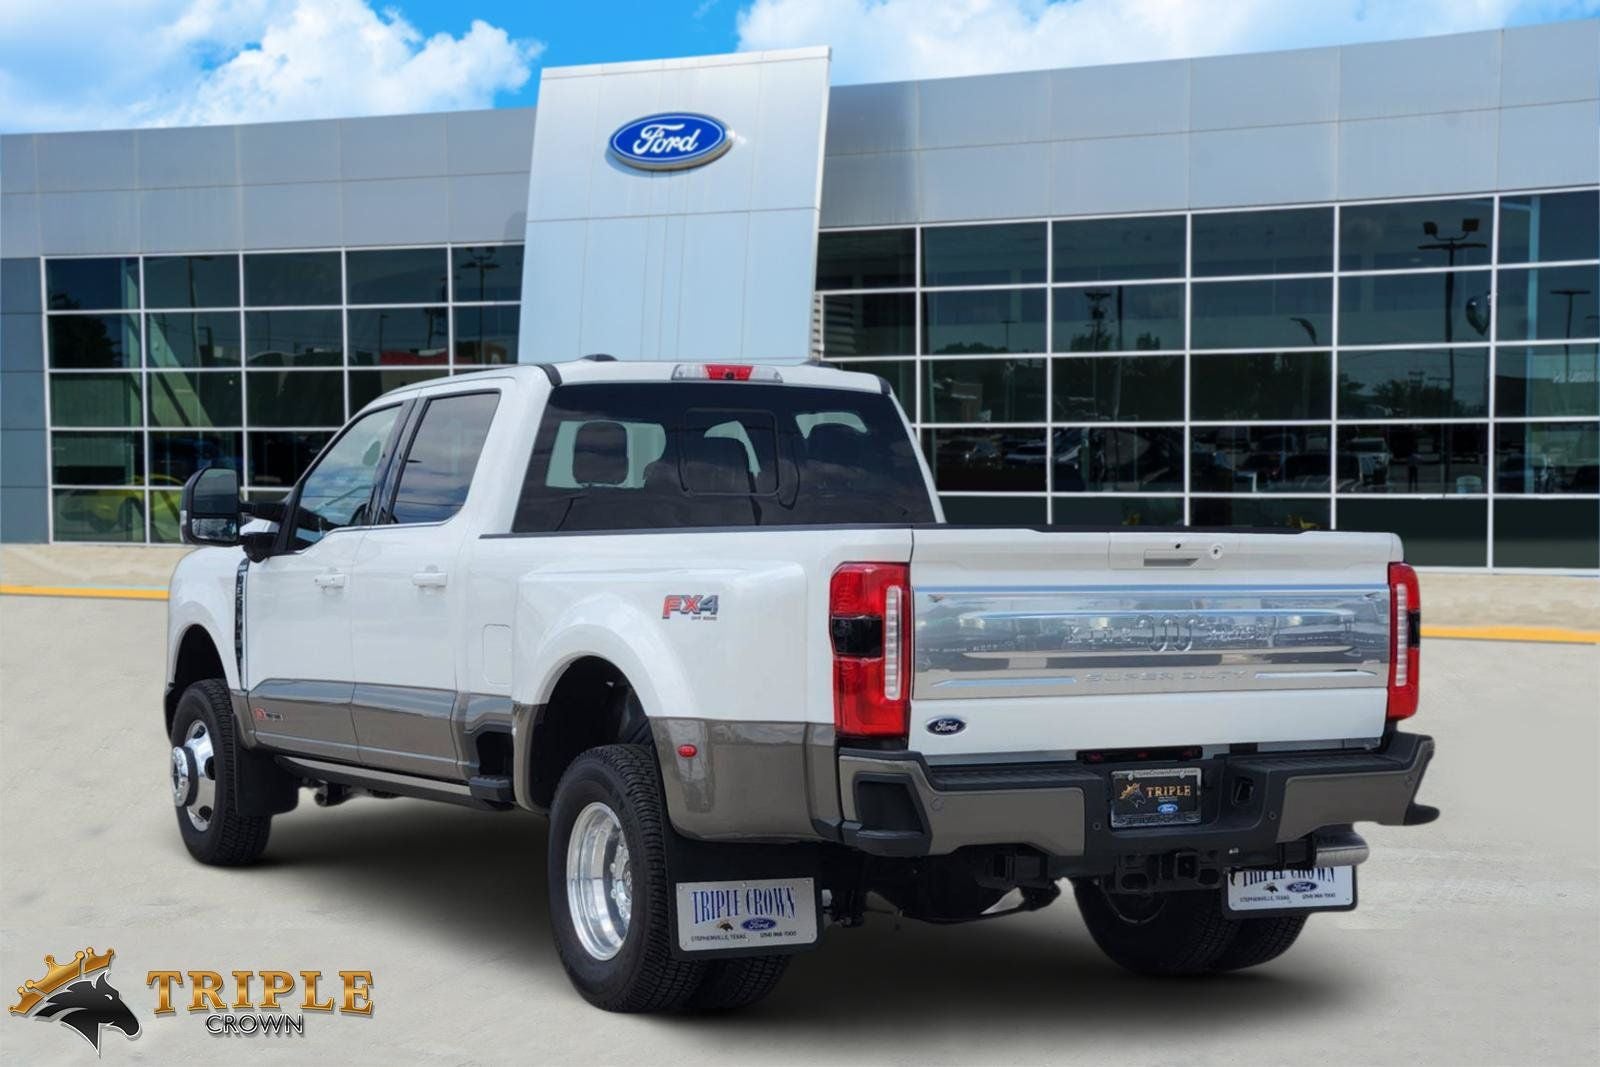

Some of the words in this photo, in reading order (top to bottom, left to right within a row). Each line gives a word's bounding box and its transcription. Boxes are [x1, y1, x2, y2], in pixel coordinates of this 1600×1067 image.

[632, 123, 702, 155] Ford
[662, 594, 719, 619] FX4
[935, 720, 959, 731] Ford
[1146, 785, 1191, 798] TRIPLE
[692, 889, 740, 924] TRIPLE
[745, 887, 796, 919] CROWN
